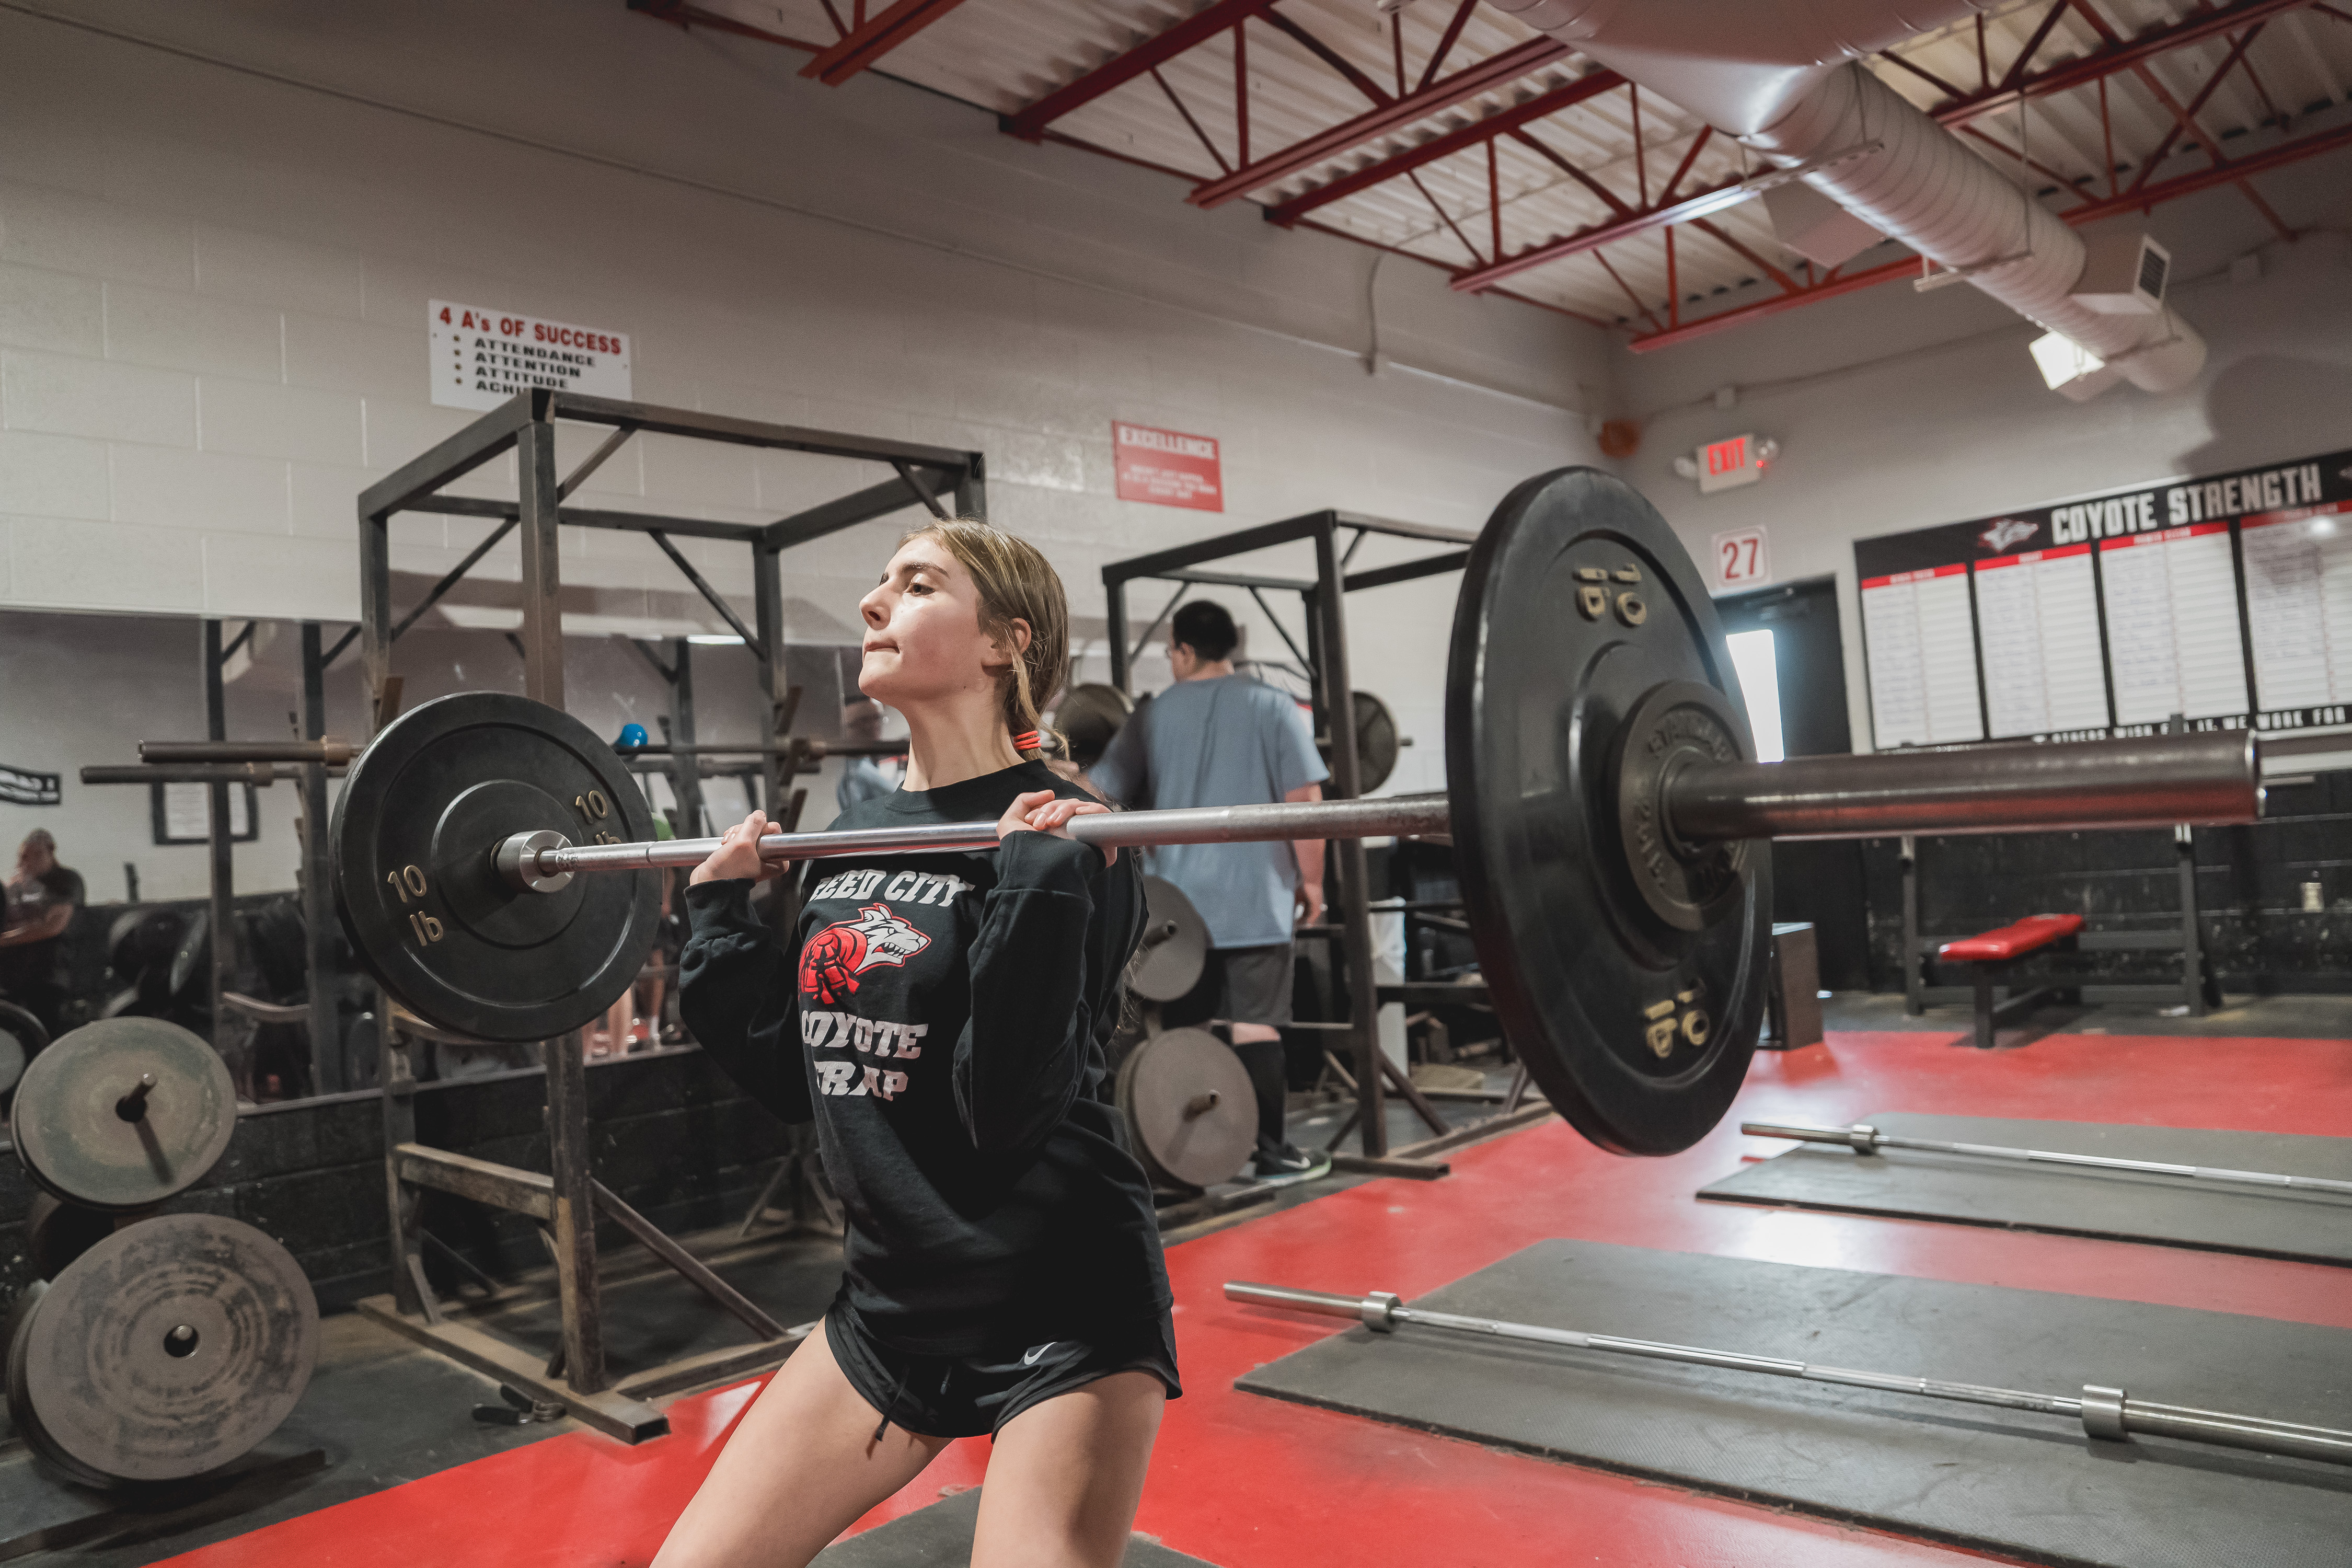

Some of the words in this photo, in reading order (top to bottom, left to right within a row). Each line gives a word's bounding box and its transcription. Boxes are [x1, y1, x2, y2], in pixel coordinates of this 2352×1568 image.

[440, 307, 451, 325] 4
[462, 310, 490, 332] A's
[500, 318, 525, 336] OF
[535, 323, 621, 355] SUCCESS
[475, 338, 595, 366] ATTENDANCE
[475, 352, 581, 378] ATTENTION
[476, 366, 569, 389] ATTITUDE
[1708, 438, 1746, 476] EXIT
[2051, 493, 2158, 545] COYOTE
[2167, 463, 2323, 525] STRENGTH
[1723, 539, 1758, 579] 27
[575, 790, 608, 824] 10
[387, 865, 426, 903] 10
[884, 870, 975, 907] CITY
[410, 911, 444, 947] lb
[801, 1010, 928, 1059] COYOTE
